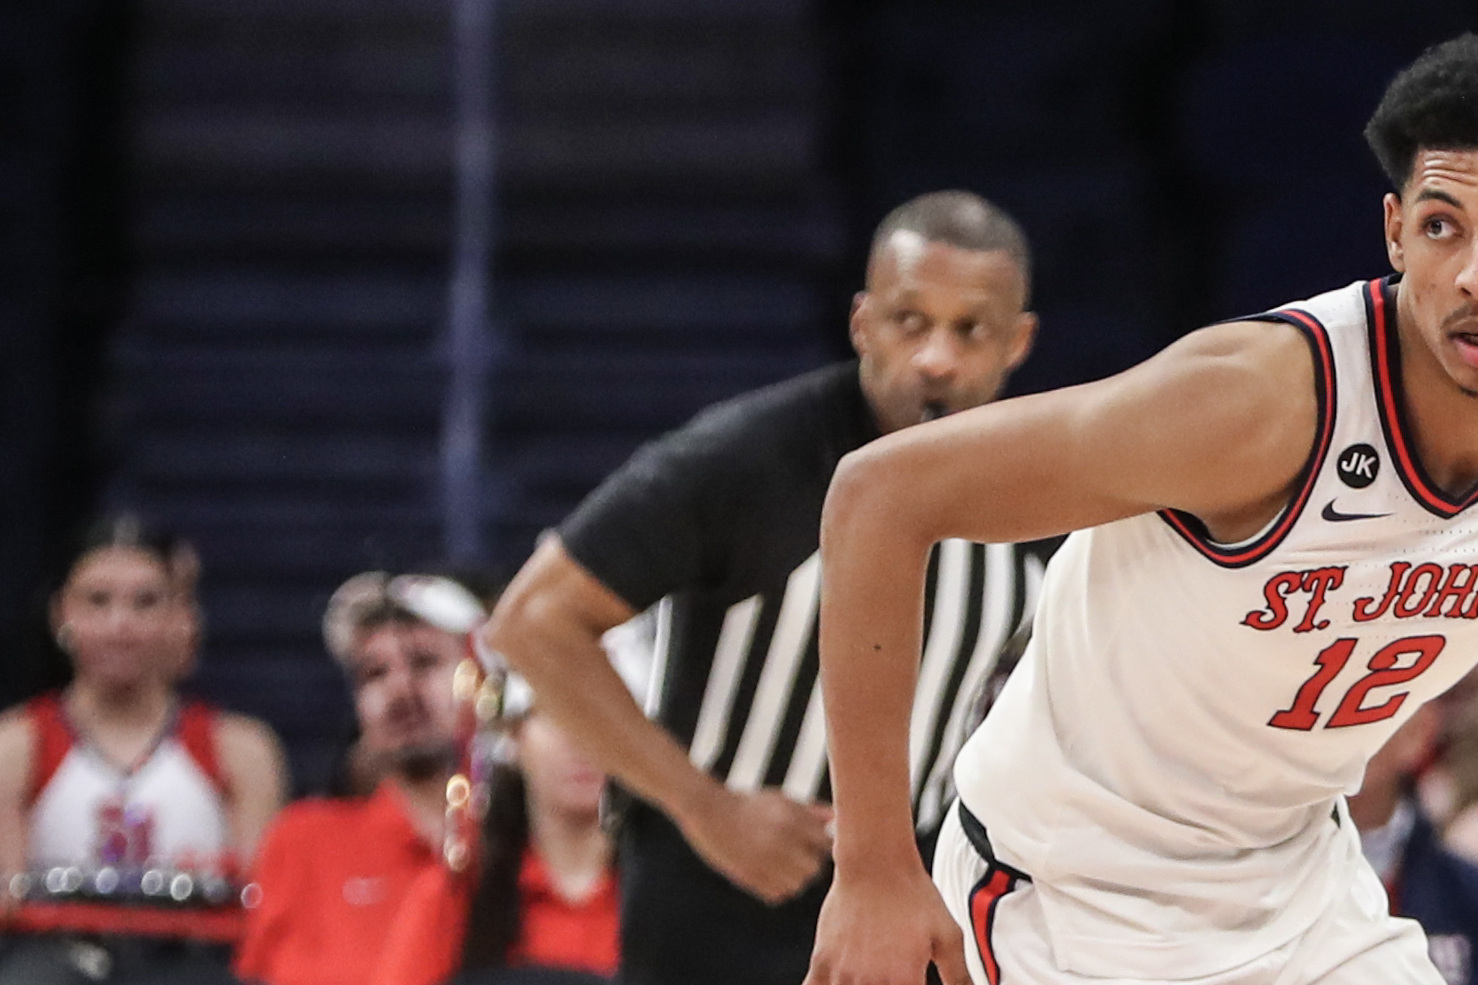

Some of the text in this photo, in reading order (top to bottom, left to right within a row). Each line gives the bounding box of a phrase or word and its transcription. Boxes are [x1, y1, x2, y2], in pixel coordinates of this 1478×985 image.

[1340, 451, 1377, 480] JK
[1239, 564, 1350, 634] ST.
[1266, 633, 1447, 732] 12
